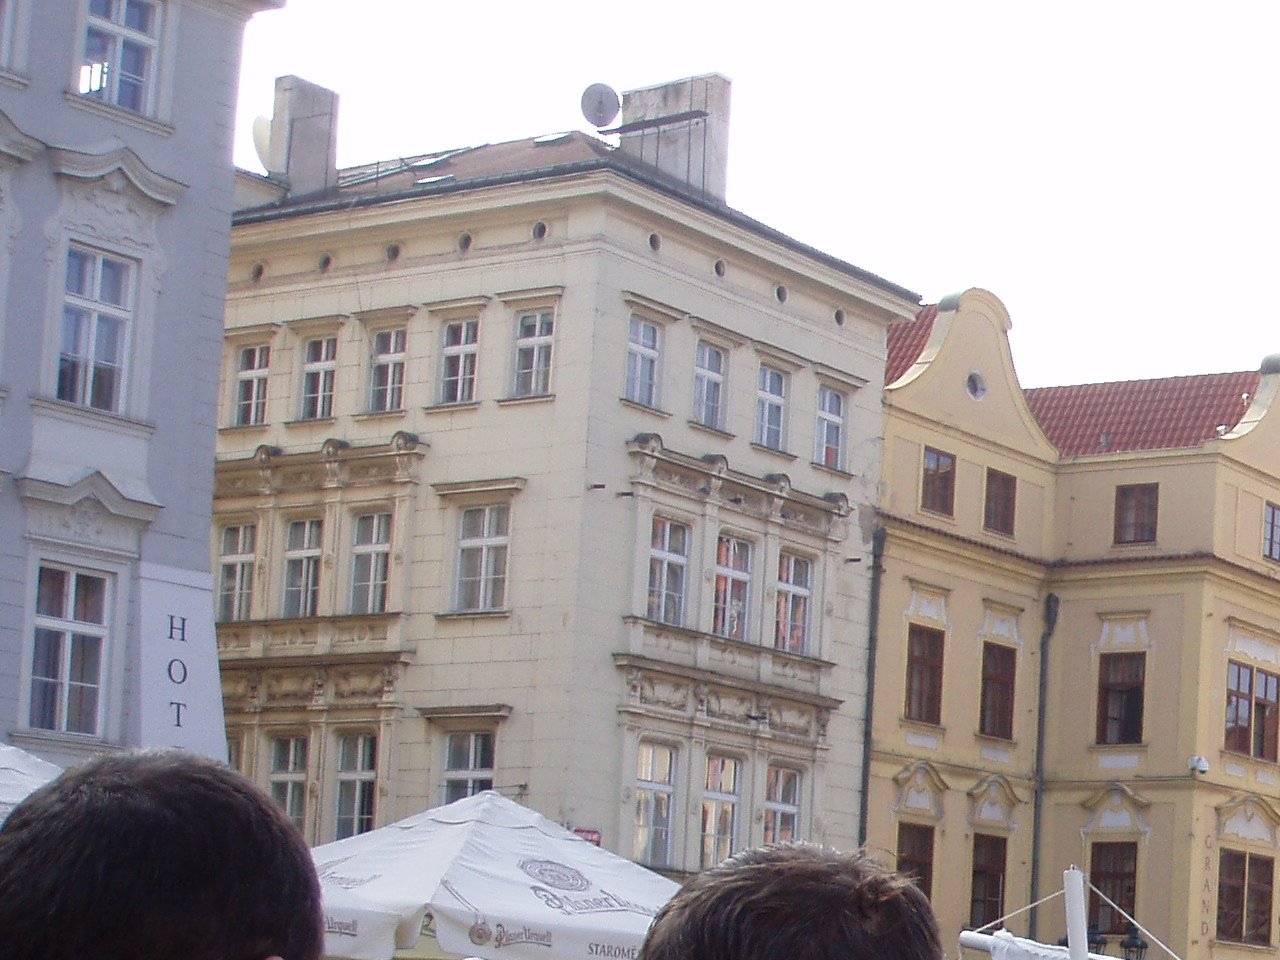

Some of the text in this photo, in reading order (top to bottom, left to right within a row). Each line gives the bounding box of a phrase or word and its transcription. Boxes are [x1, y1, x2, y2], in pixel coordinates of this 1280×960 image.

[167, 614, 188, 749] HOT
[495, 924, 525, 948] Pilsner
[1201, 835, 1213, 936] GRAND
